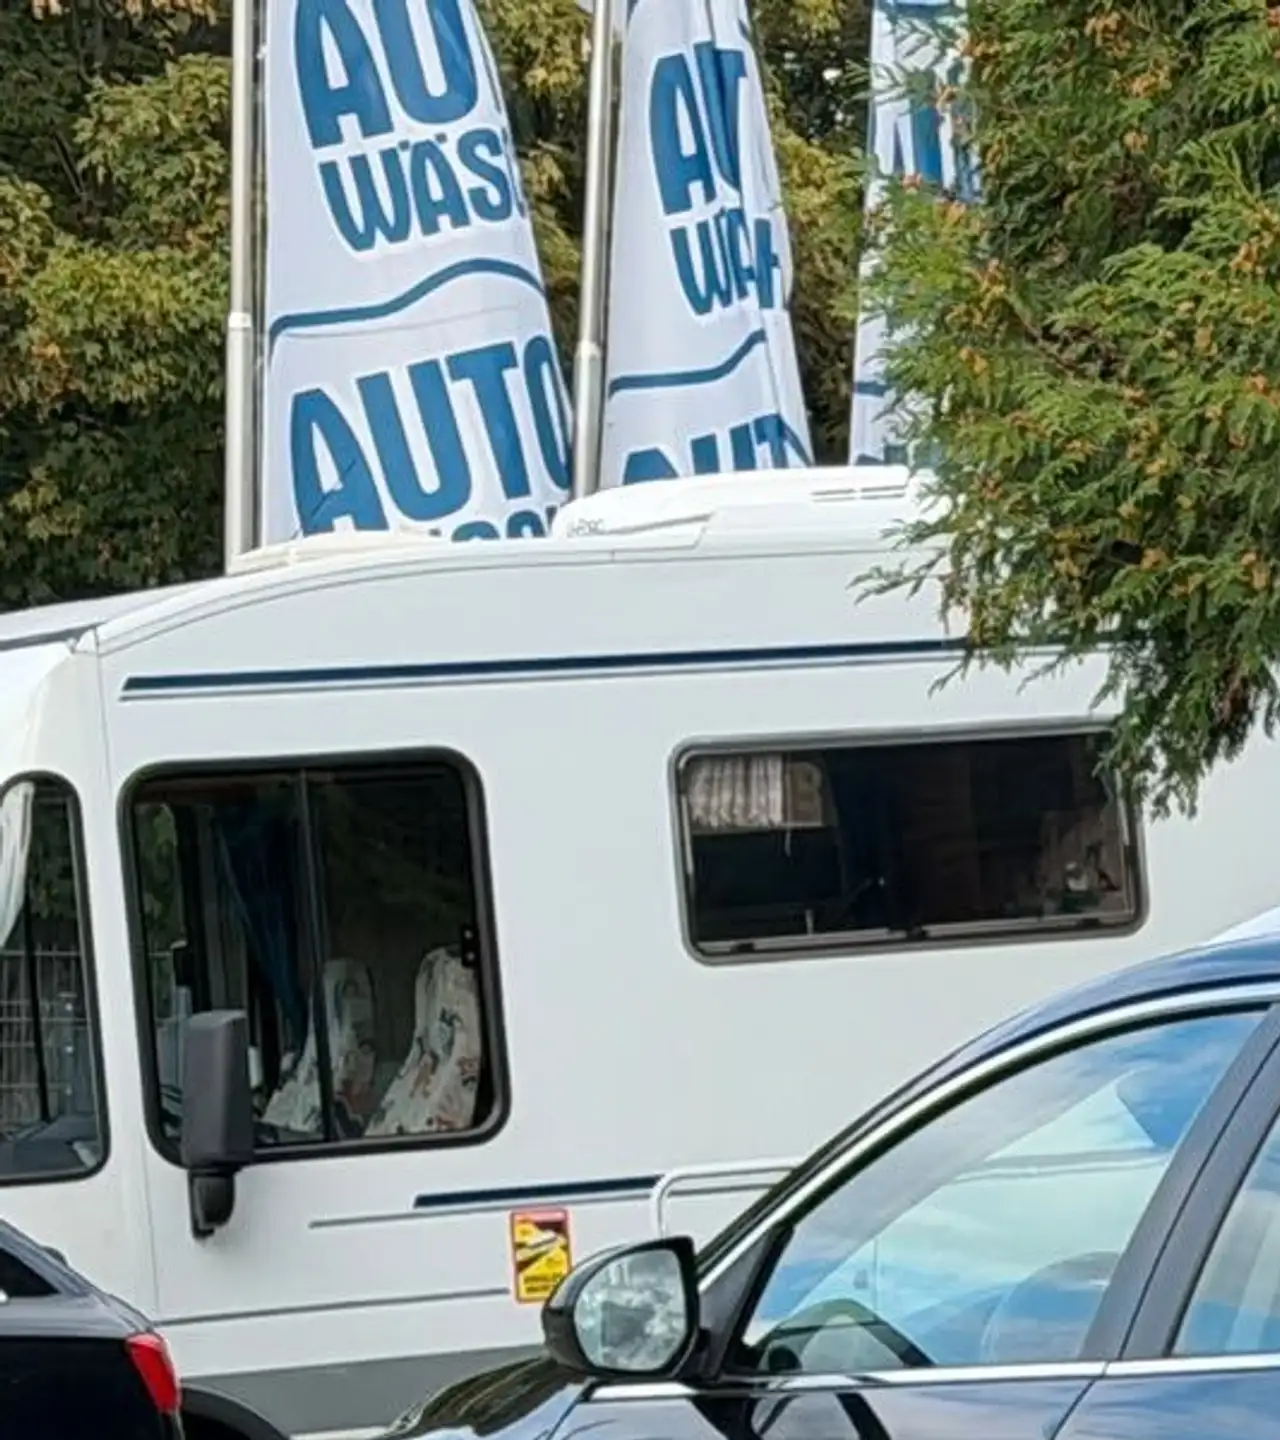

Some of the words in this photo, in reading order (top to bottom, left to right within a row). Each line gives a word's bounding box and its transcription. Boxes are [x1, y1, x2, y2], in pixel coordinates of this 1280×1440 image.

[295, 0, 480, 150] AU
[318, 127, 518, 252] WÄS
[291, 338, 572, 536] AUTO
